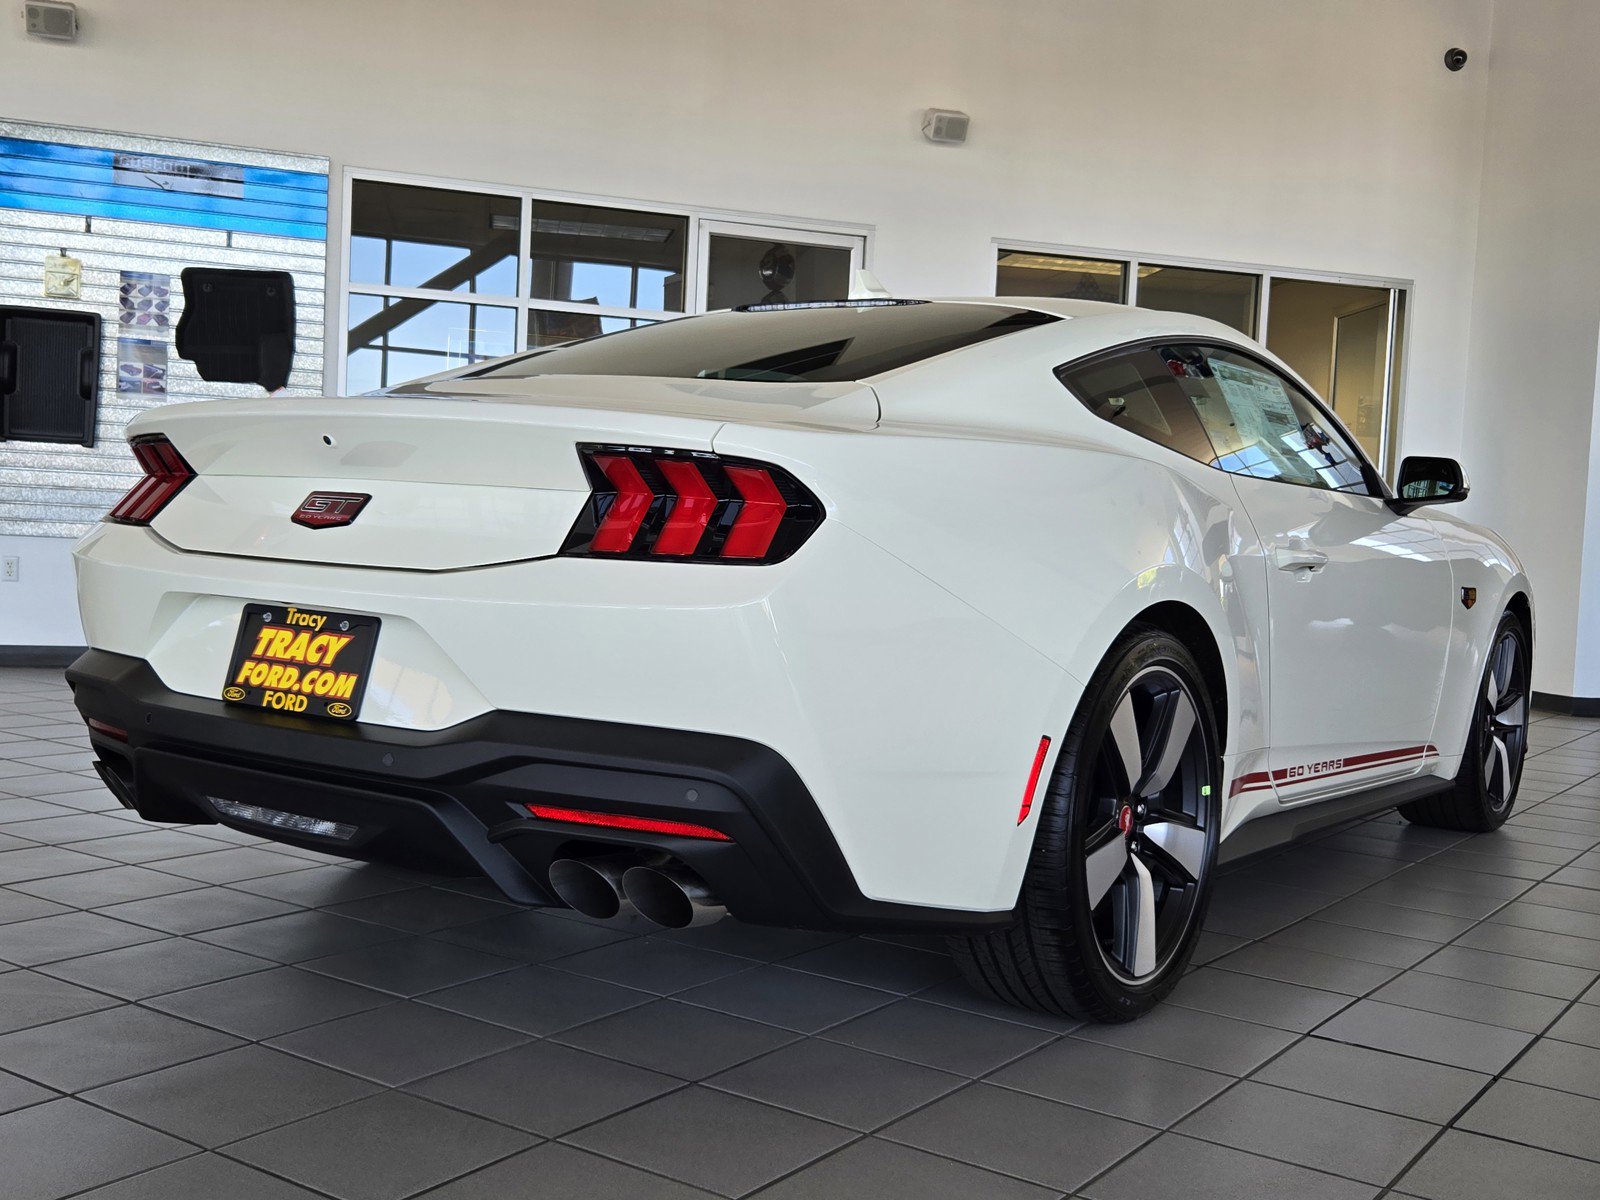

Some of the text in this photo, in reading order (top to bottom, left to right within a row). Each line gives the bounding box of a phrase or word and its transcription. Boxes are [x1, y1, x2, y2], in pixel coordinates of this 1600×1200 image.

[301, 495, 363, 514] GT
[286, 607, 327, 632] Tracy
[252, 626, 354, 666] TRACY
[236, 660, 358, 699] FORD.COM
[262, 690, 308, 712] FORD
[1289, 759, 1342, 778] 60 YEARS
